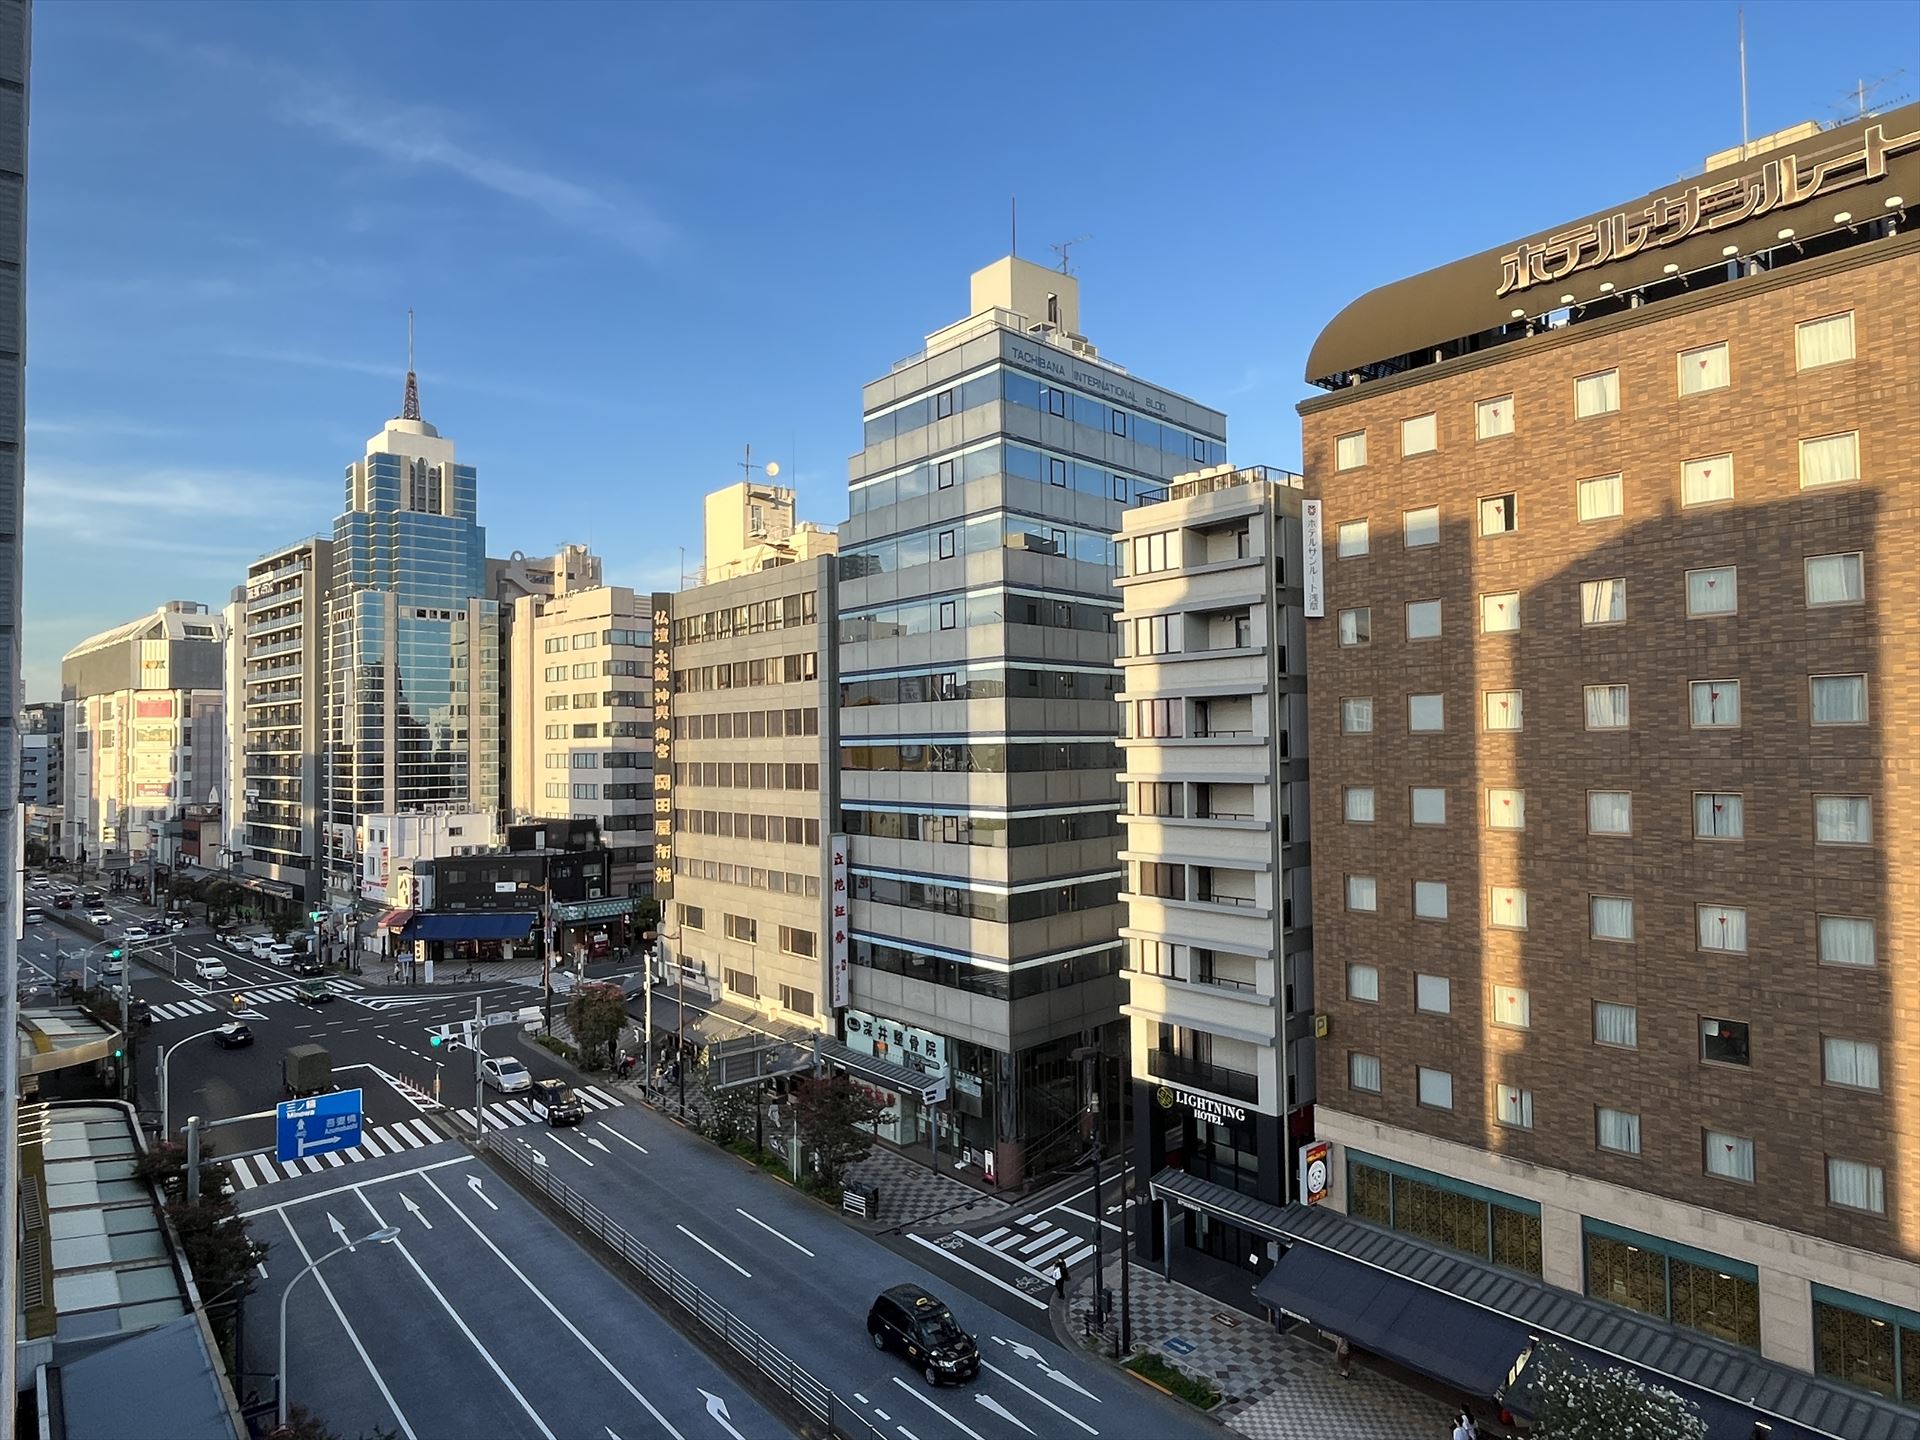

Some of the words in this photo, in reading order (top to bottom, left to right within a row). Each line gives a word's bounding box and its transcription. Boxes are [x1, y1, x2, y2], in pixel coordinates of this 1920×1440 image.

[1496, 123, 1920, 296] ホテルサンルート
[1011, 347, 1066, 377] TACHIBANA
[1073, 370, 1138, 402] INTERNATIONAL
[863, 1020, 937, 1058] 深井整骨院
[1175, 1090, 1246, 1122] LIGHTNING
[1193, 1108, 1224, 1126] HOTEL
